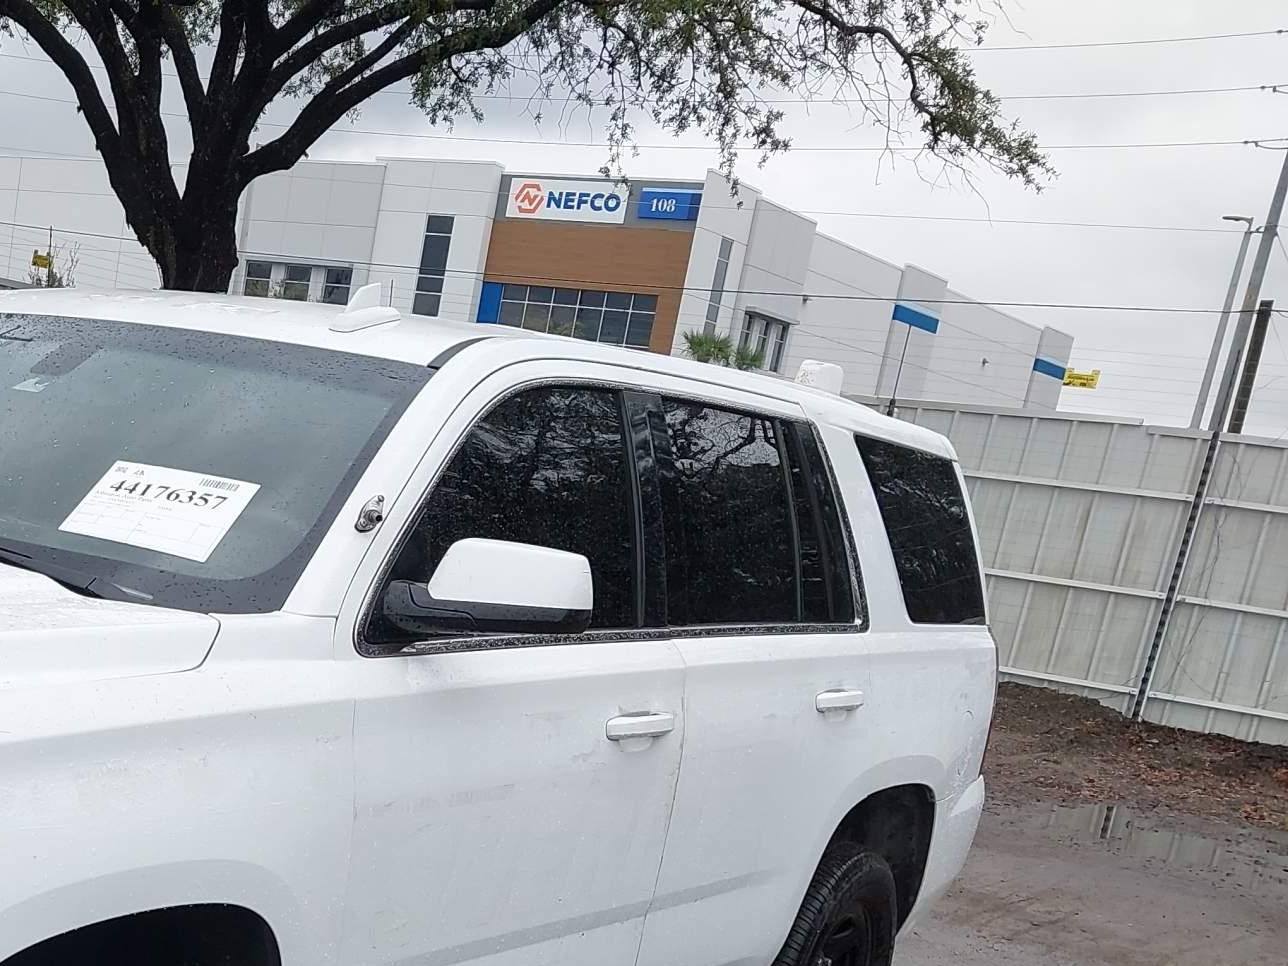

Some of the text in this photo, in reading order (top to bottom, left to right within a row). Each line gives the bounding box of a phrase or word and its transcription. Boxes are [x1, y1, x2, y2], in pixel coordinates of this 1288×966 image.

[545, 190, 621, 212] NEFCO
[649, 198, 677, 213] 108
[111, 480, 228, 509] 44176357
